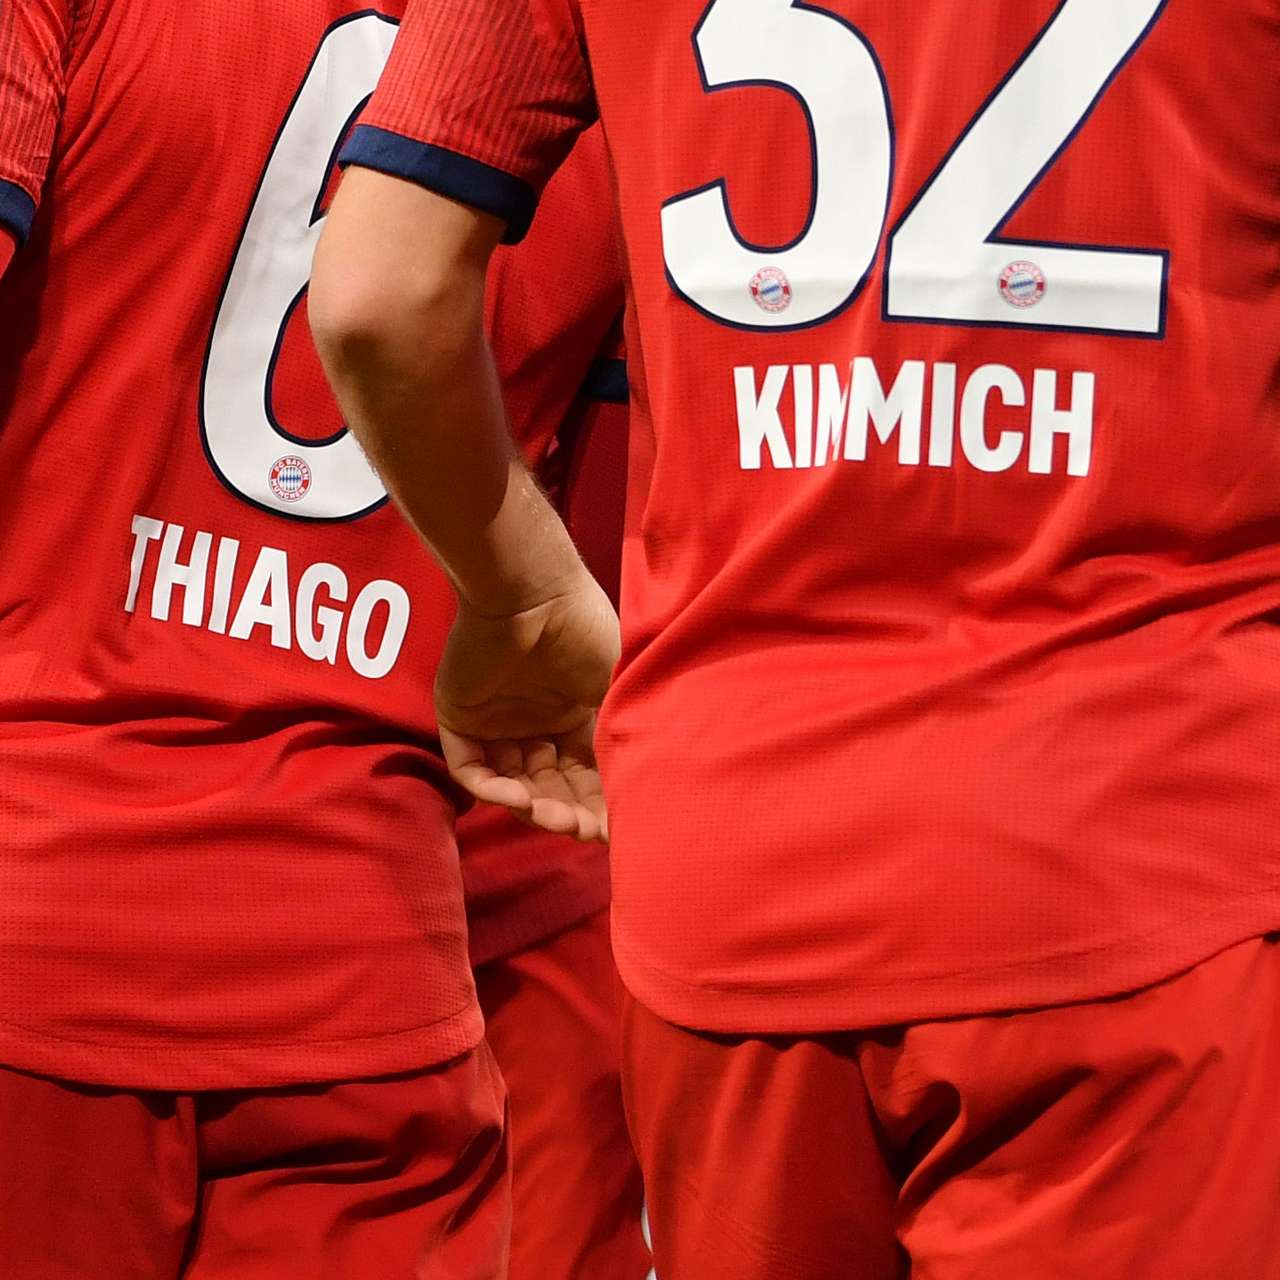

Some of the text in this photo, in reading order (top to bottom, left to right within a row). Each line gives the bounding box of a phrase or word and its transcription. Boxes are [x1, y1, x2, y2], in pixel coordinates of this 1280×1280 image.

[198, 8, 400, 523] 6
[733, 357, 1095, 477] KIMMICH
[124, 514, 411, 680] THIAGO
